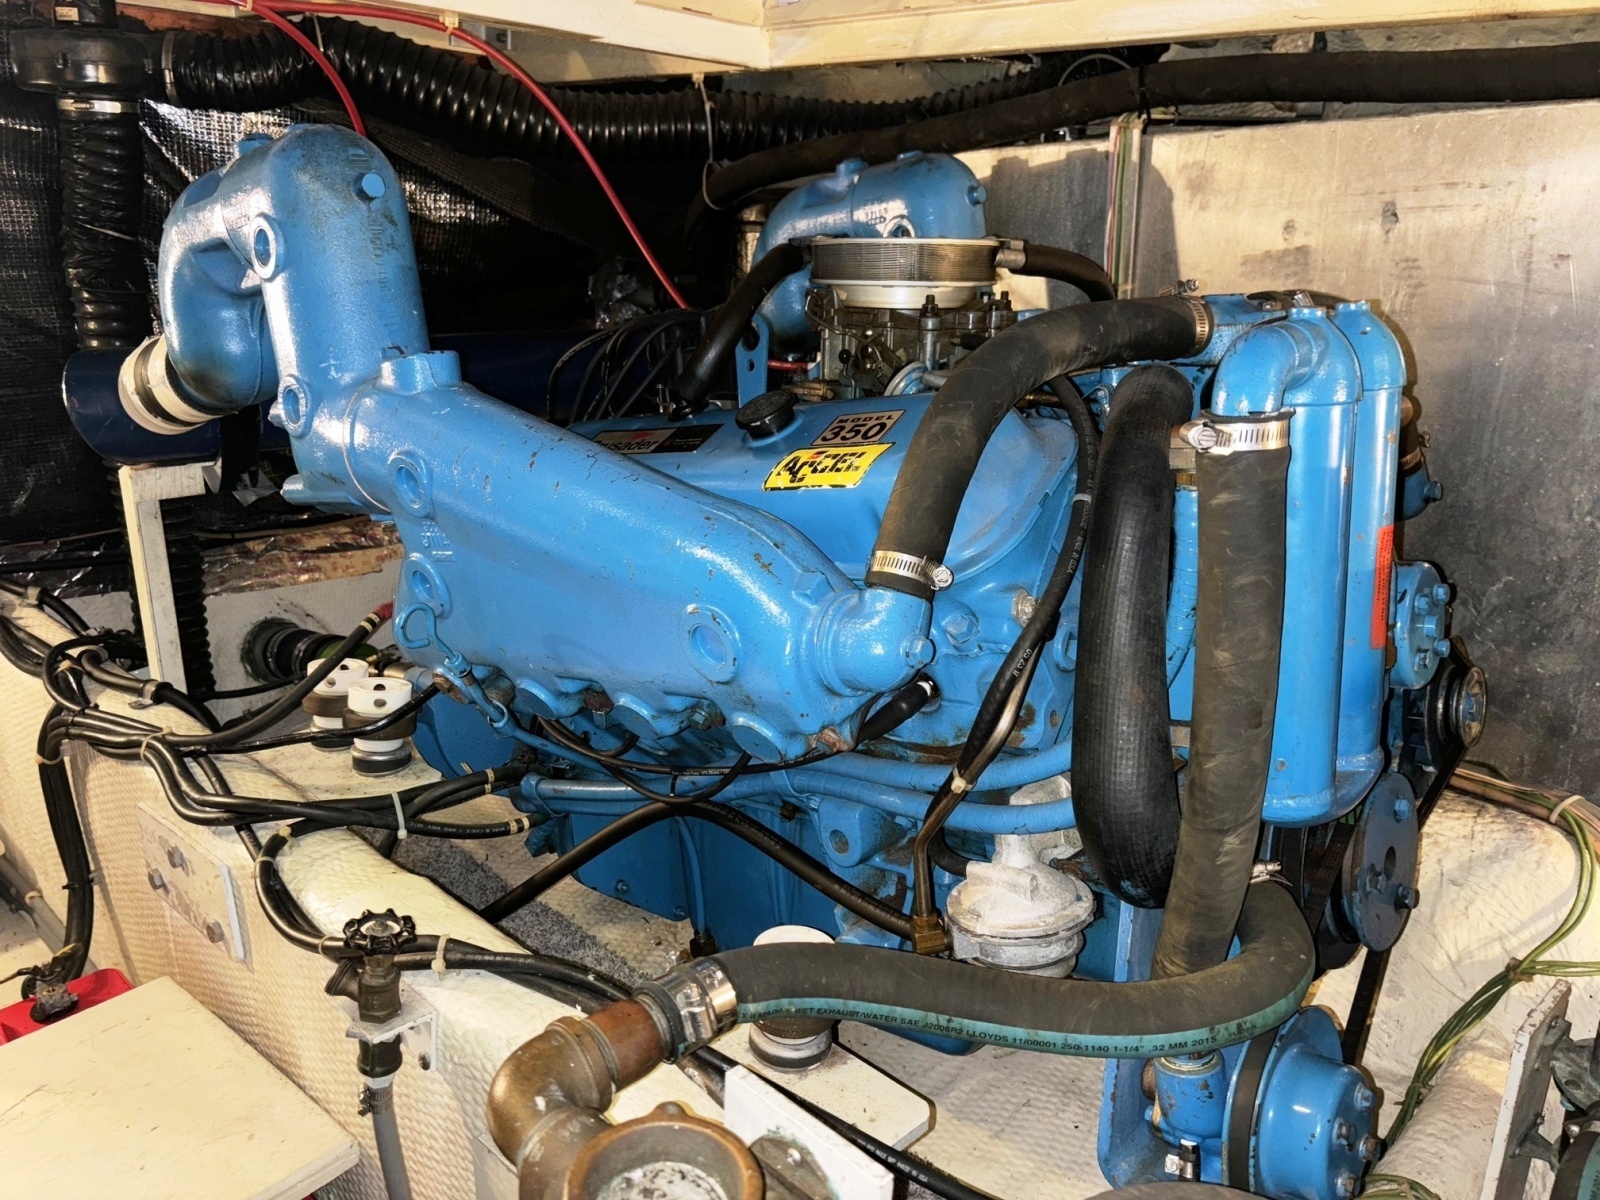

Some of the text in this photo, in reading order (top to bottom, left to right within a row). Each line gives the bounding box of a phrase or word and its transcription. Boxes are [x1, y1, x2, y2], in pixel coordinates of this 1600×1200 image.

[836, 414, 895, 425] MODEL
[820, 421, 887, 443] 350
[757, 1008, 795, 1019] MARINE
[794, 1007, 816, 1016] WET
[816, 1007, 898, 1024] EXHAUST/WATER
[900, 1017, 920, 1028] SAE
[922, 1020, 964, 1035] J2006R2
[965, 1029, 1009, 1043] LLOYDS
[1012, 1037, 1058, 1049] 11/00001
[1060, 1042, 1110, 1053] 250-1140
[1112, 1044, 1145, 1054] 1-1/4"
[1167, 1040, 1188, 1051] MM
[1190, 1035, 1218, 1047] 2015
